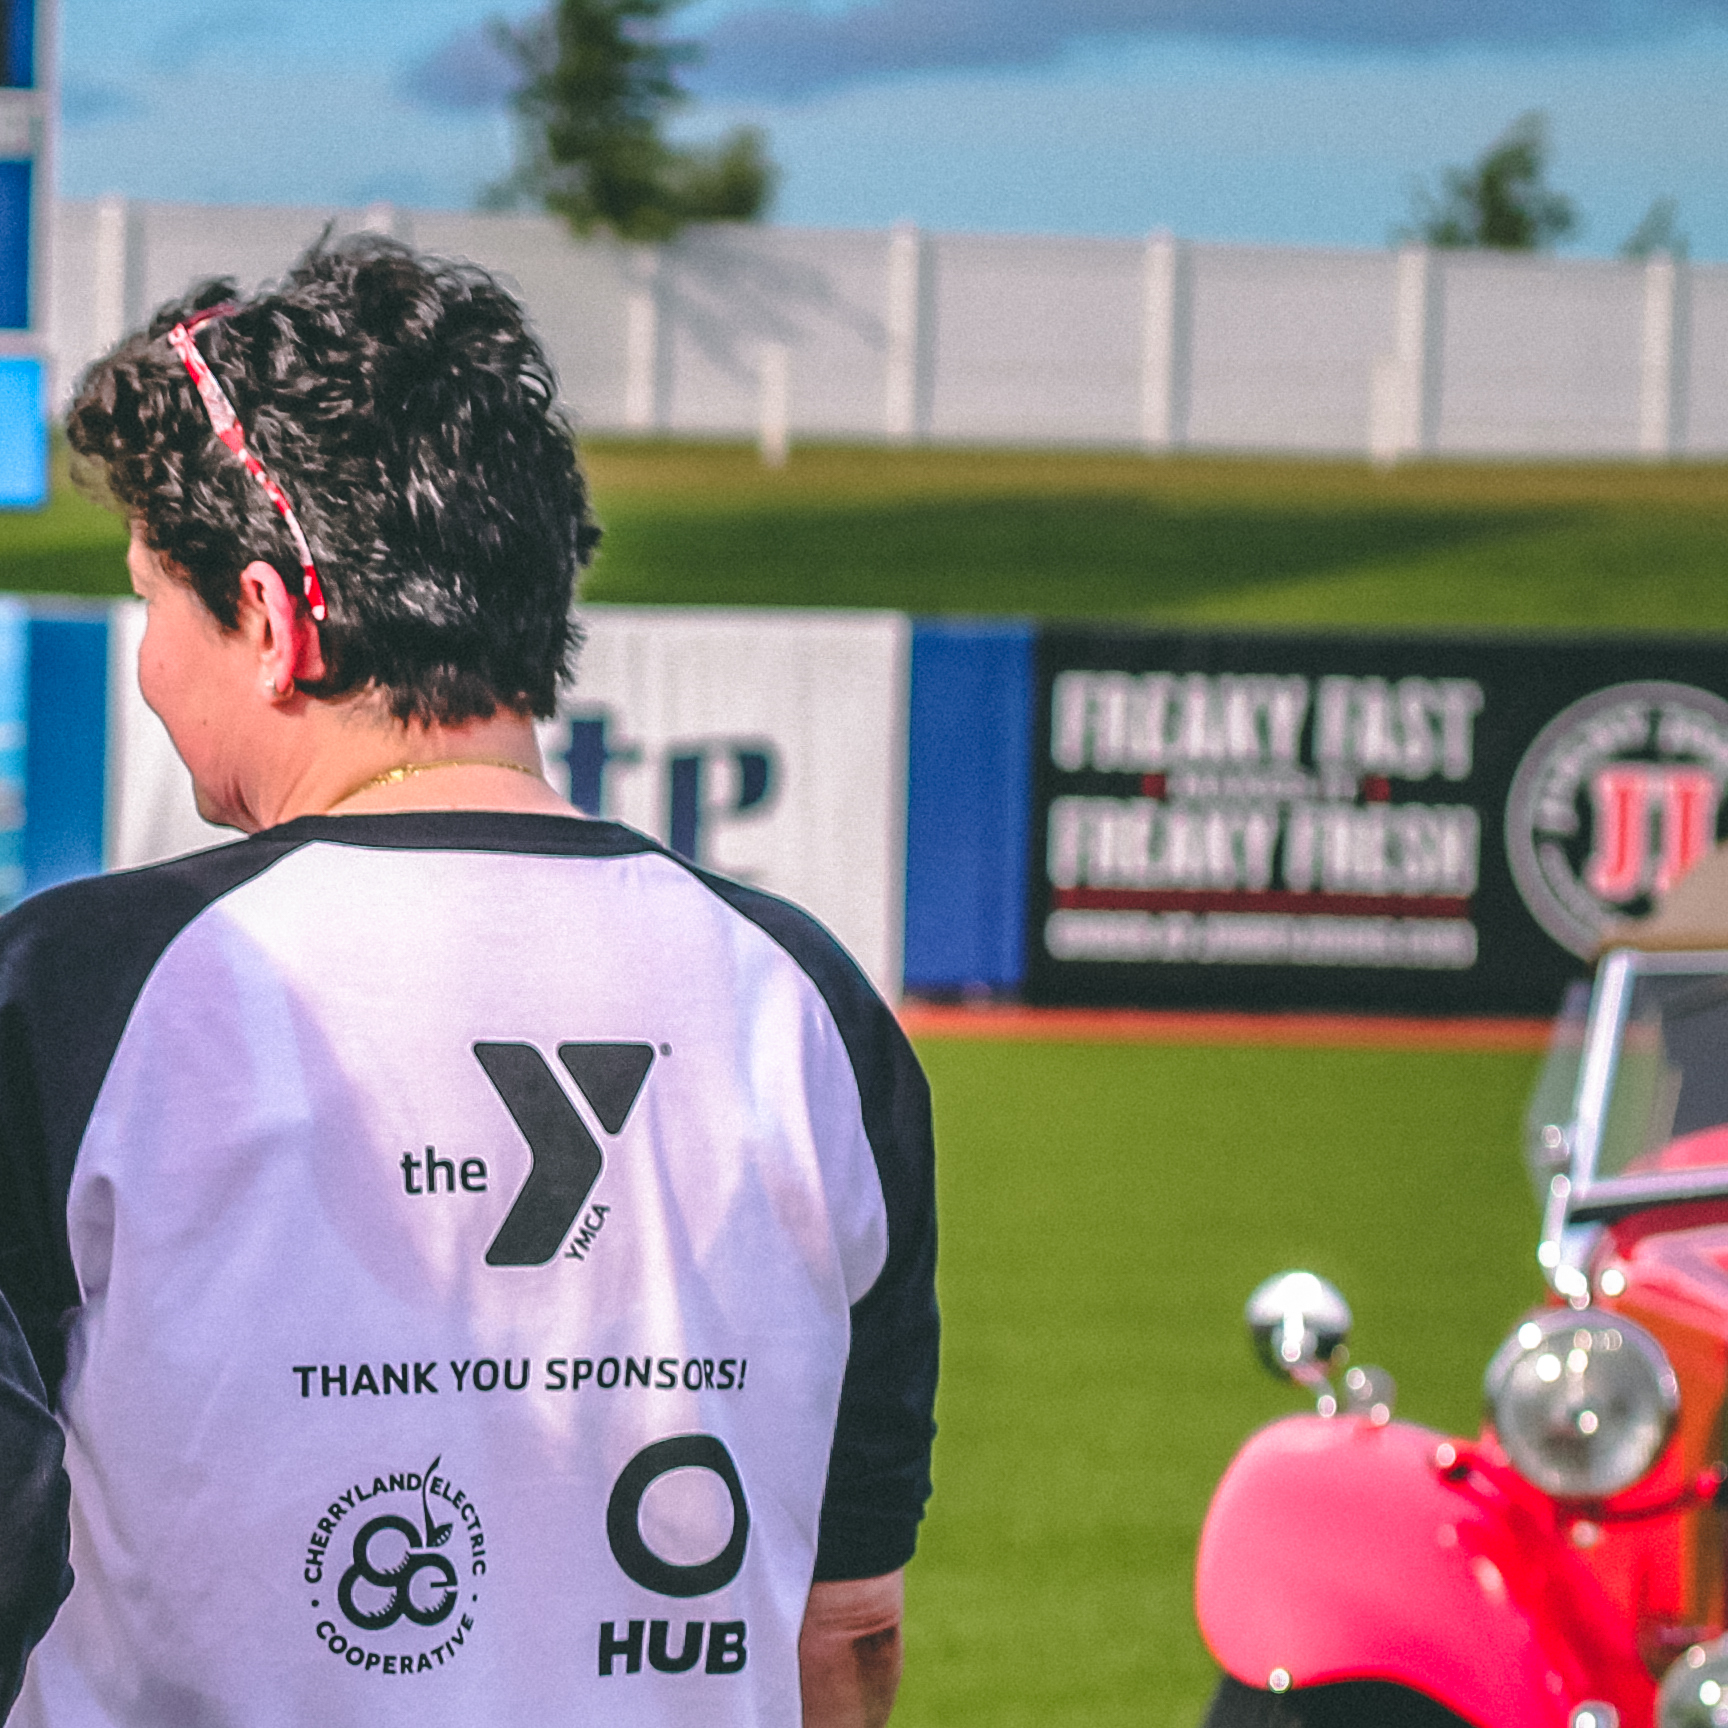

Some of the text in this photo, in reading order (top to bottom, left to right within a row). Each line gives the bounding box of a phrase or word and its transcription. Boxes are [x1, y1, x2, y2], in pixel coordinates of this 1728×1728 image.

[401, 1146, 488, 1194] the
[564, 1202, 611, 1262] YMCA
[293, 1357, 747, 1398] THANK YOU SPONSORS!
[304, 1473, 486, 1584] CHERRYLAND ELECTRIC
[316, 1612, 474, 1674] COOPERATIVE
[599, 1620, 747, 1676] HUB
